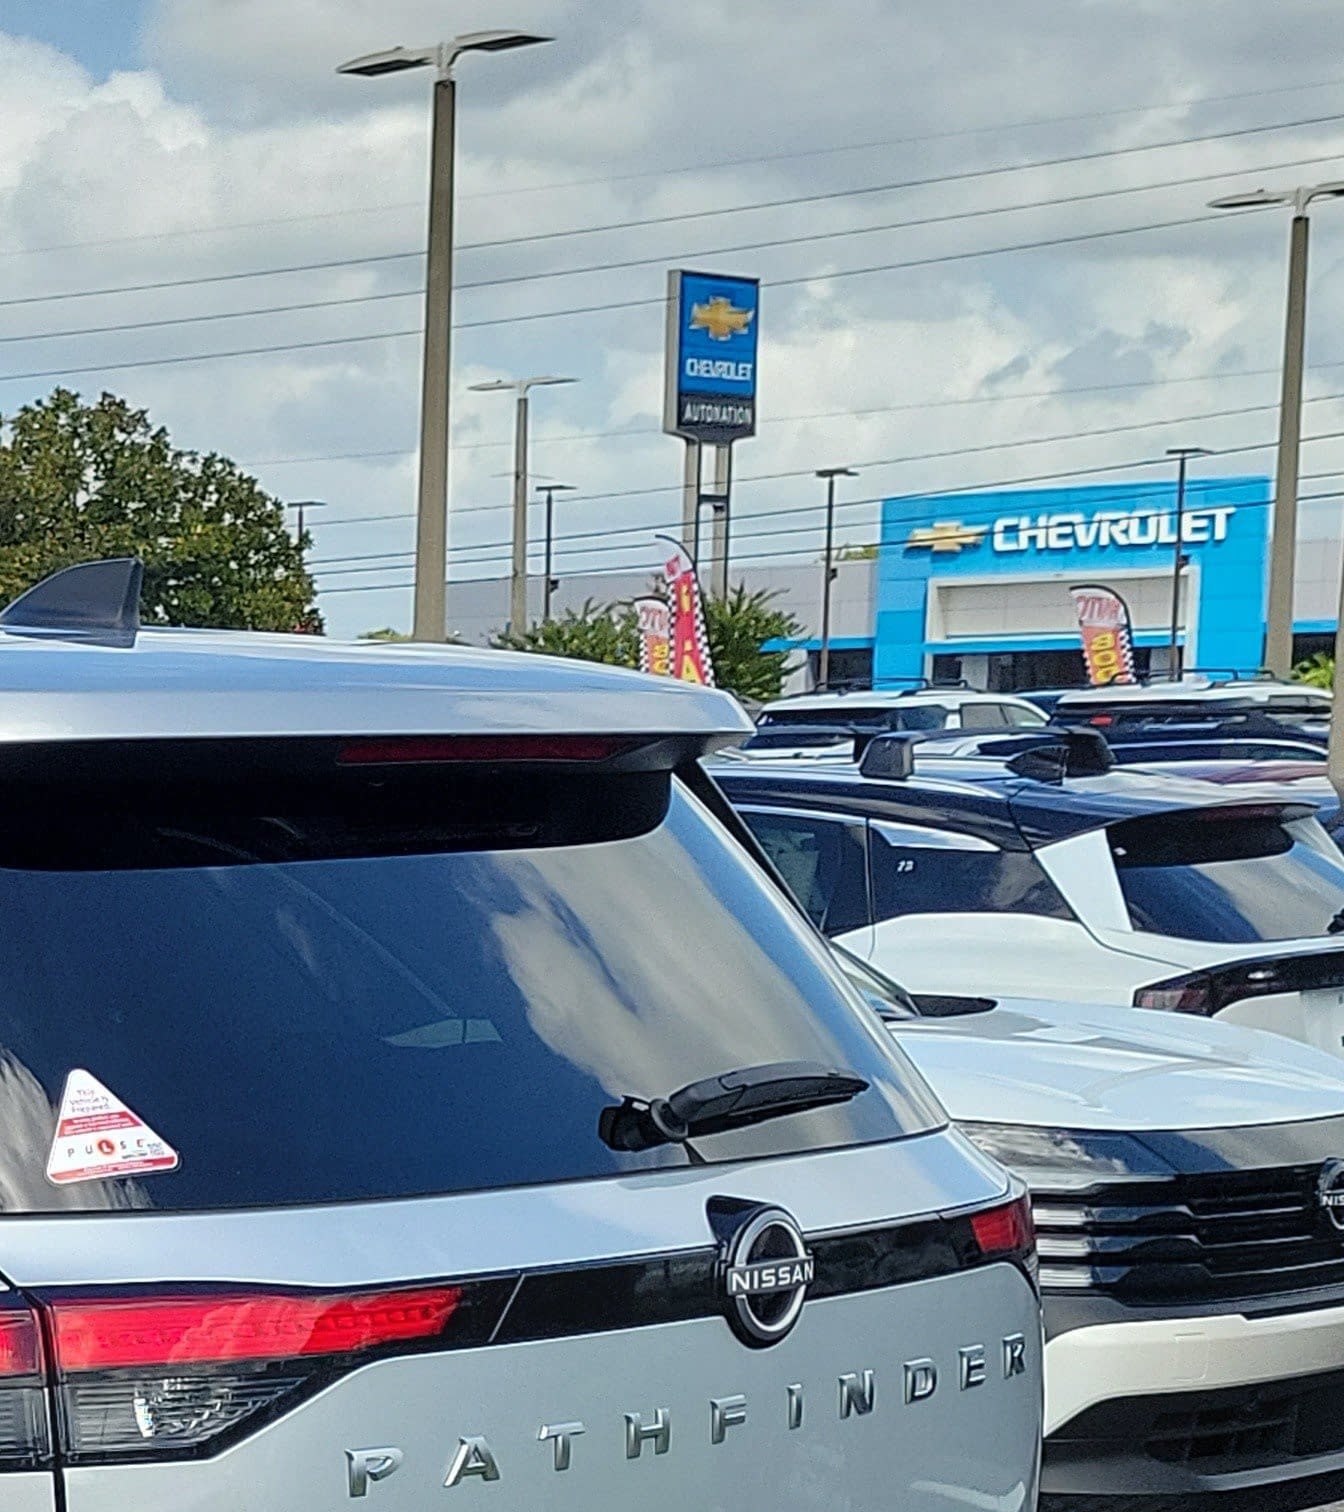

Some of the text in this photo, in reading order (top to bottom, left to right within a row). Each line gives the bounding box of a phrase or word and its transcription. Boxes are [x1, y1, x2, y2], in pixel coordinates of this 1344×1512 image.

[685, 357, 753, 381] CHEVROLET
[683, 402, 752, 425] AUTONATION
[992, 506, 1237, 552] CHEVROLET
[732, 1260, 813, 1292] NISSAN
[343, 1332, 1026, 1498] PATHFINDER
